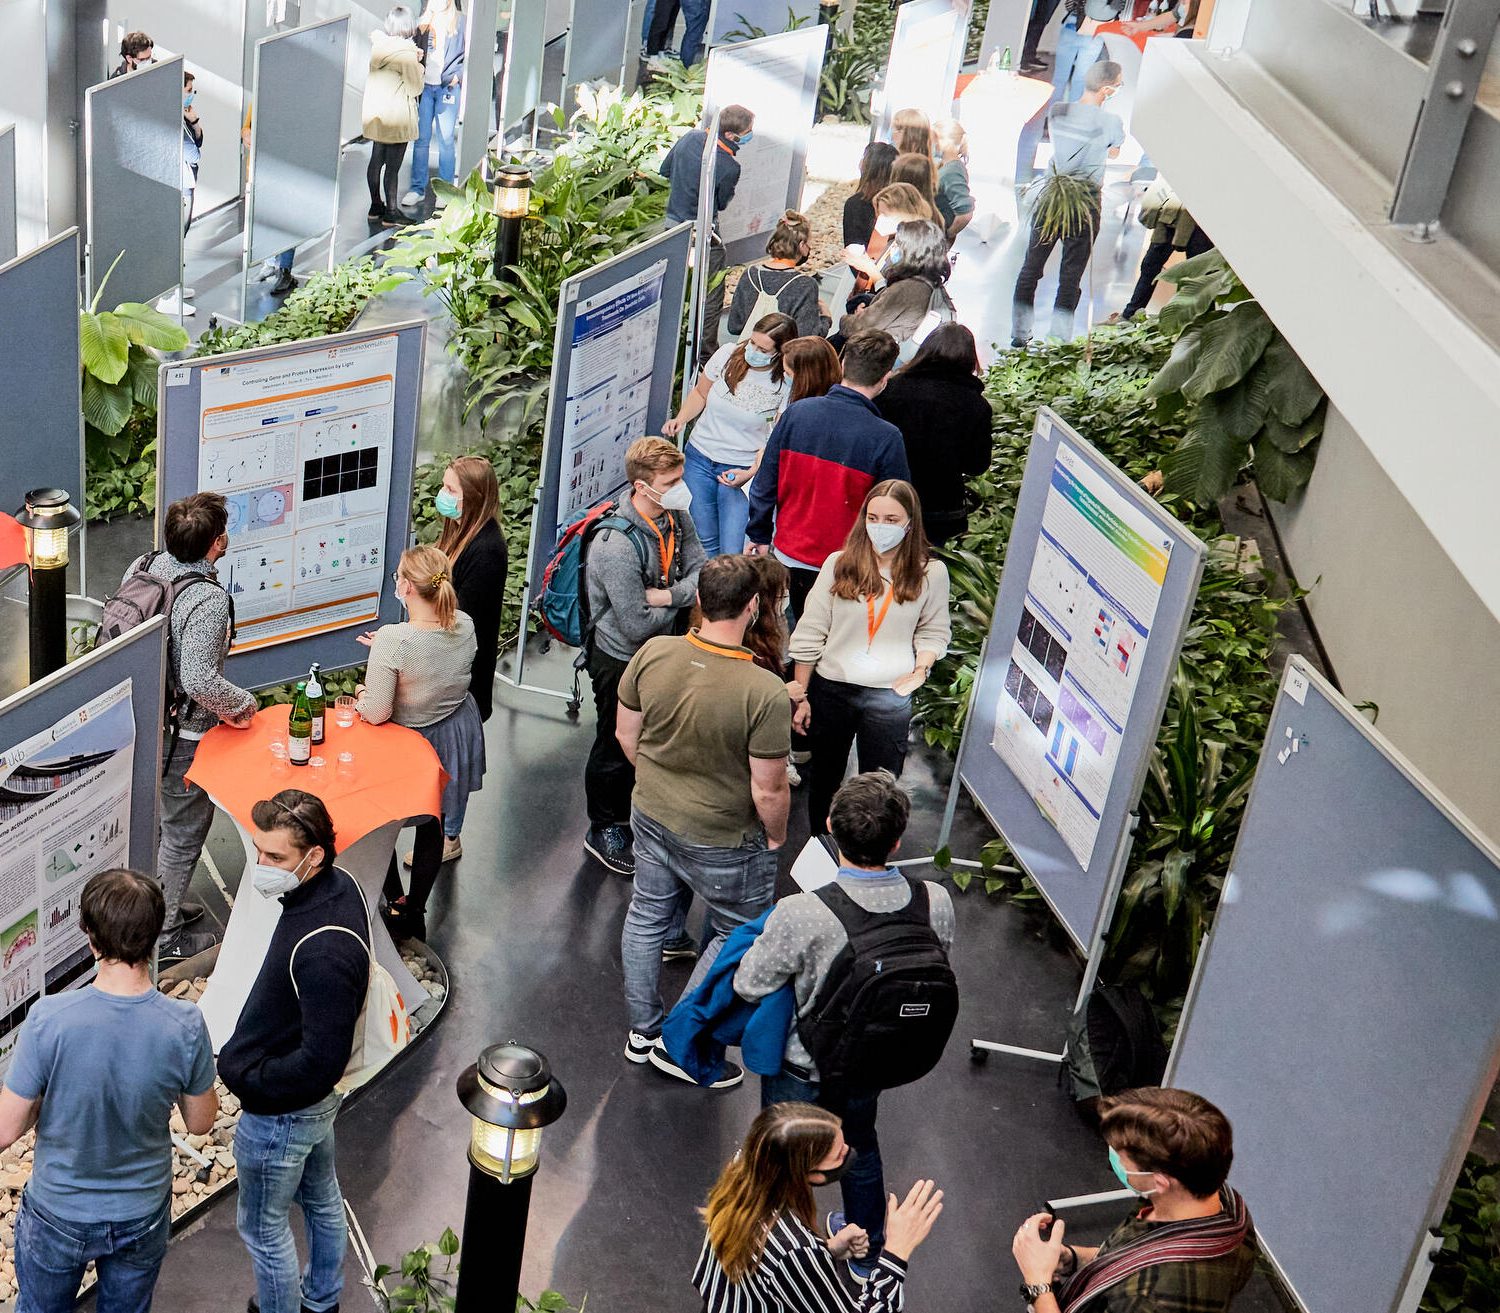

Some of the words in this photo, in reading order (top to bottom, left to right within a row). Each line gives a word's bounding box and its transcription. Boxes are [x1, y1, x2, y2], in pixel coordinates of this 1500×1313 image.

[10, 813, 38, 832] activation
[38, 807, 44, 816] in
[44, 792, 70, 812] intestinal
[70, 779, 94, 798] epithelial
[94, 769, 106, 782] cells
